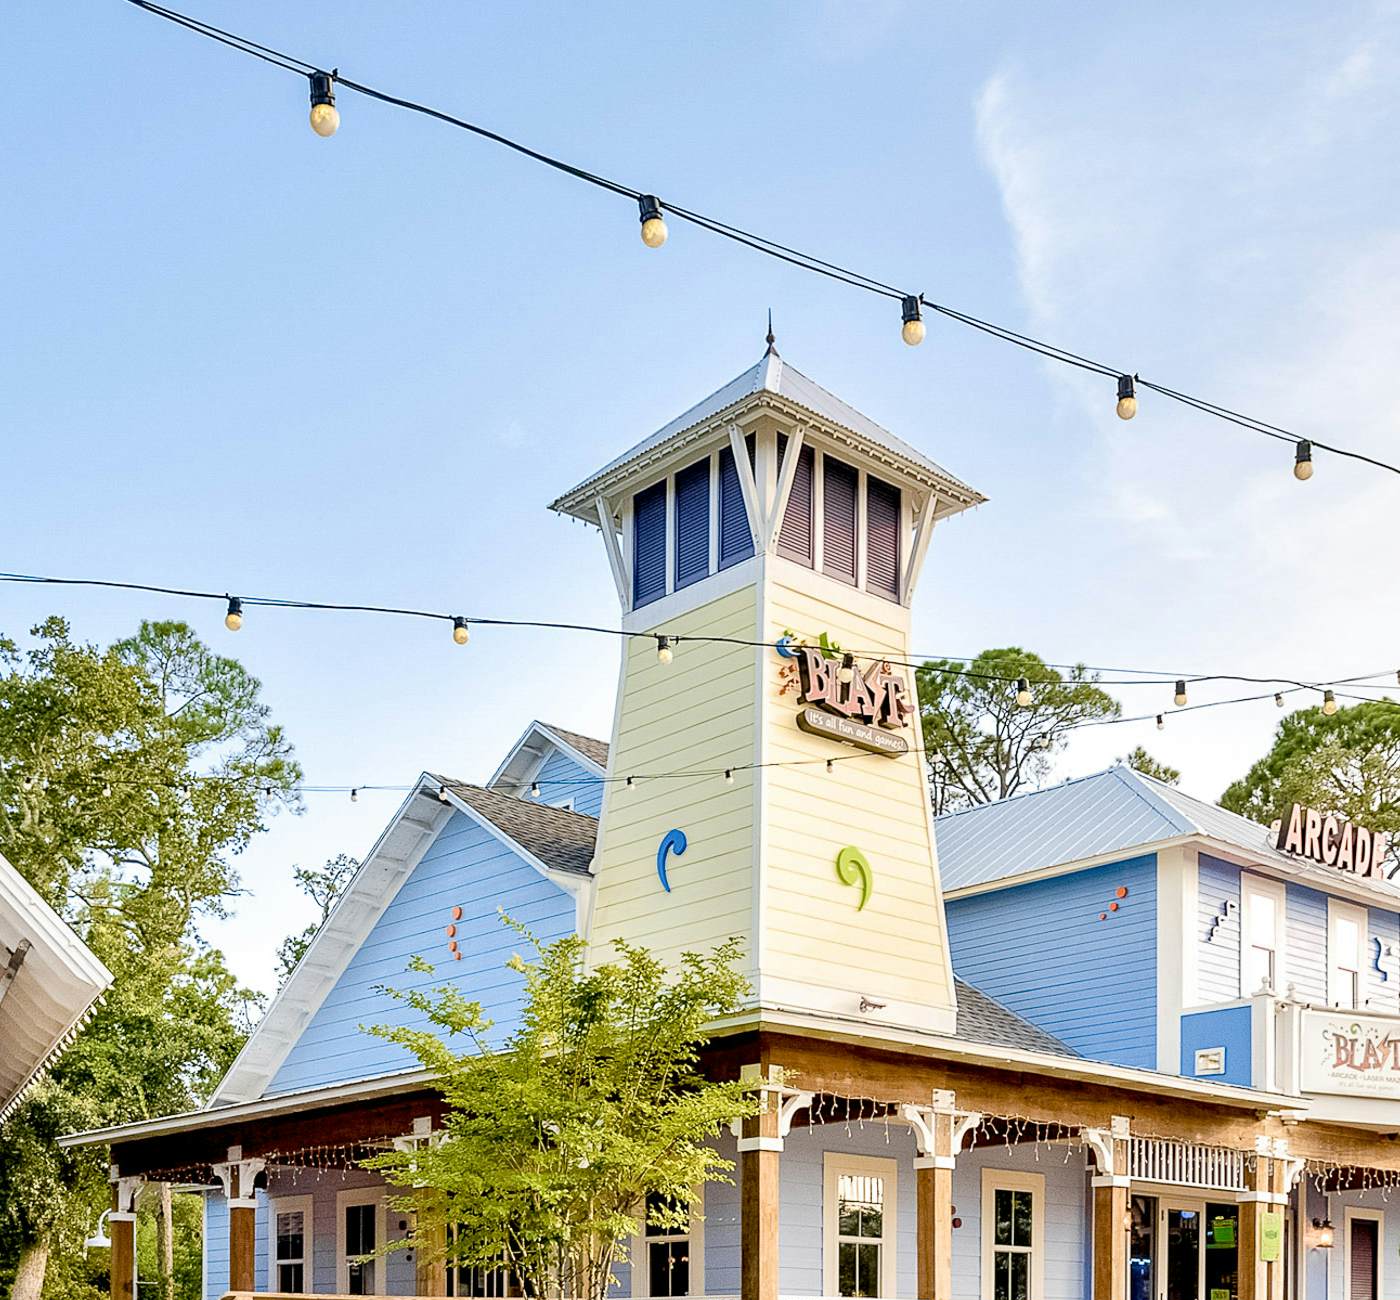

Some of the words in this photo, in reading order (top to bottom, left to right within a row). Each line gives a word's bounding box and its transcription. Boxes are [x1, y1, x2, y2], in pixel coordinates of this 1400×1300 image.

[801, 648, 905, 728] BLAST
[825, 716, 836, 729] all
[838, 719, 854, 735] fun
[856, 728, 872, 741] and
[1284, 803, 1386, 880] ARCADE
[1331, 1031, 1400, 1072] BLAST
